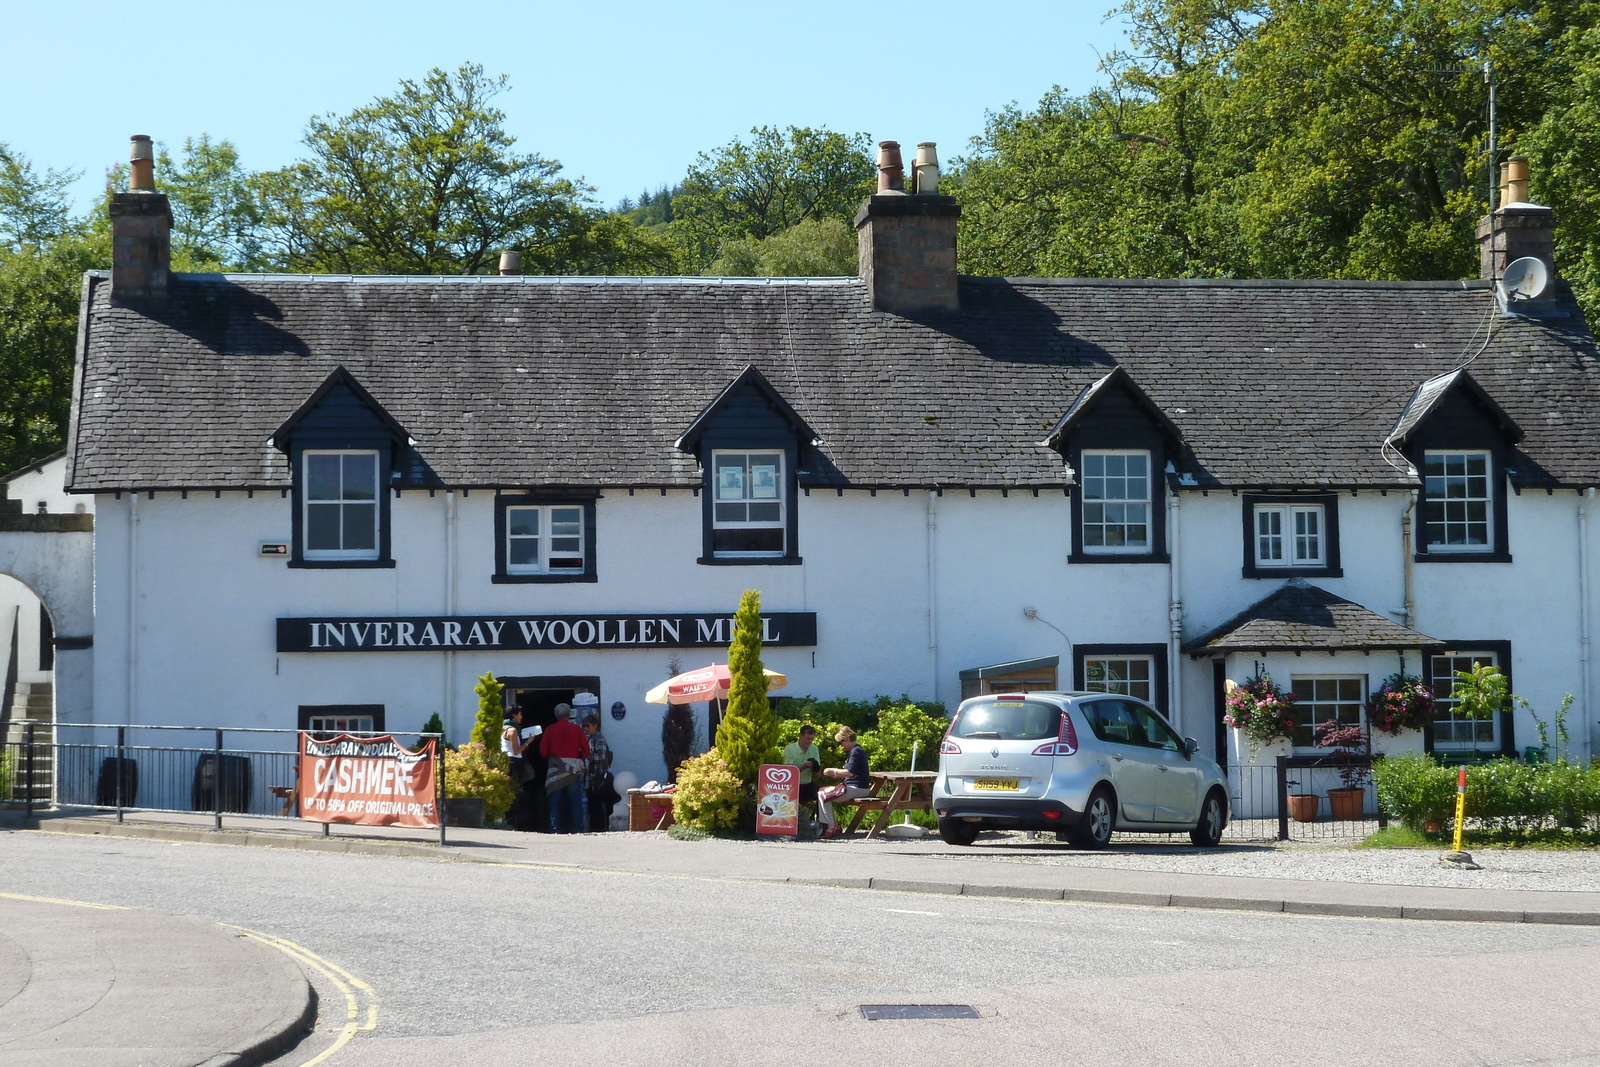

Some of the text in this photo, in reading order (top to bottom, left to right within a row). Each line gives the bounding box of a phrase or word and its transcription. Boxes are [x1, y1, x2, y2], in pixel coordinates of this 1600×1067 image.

[309, 617, 780, 648] INVERARAY WOOLLEN MIL
[682, 683, 708, 693] WALL'S
[766, 783, 791, 791] WALL'S
[978, 780, 1018, 790] SH59 YYJ
[304, 797, 315, 810] UP
[316, 798, 326, 811] TO
[327, 798, 345, 812] 50%
[347, 800, 365, 813] OFF
[366, 801, 407, 815] ORIGINAL
